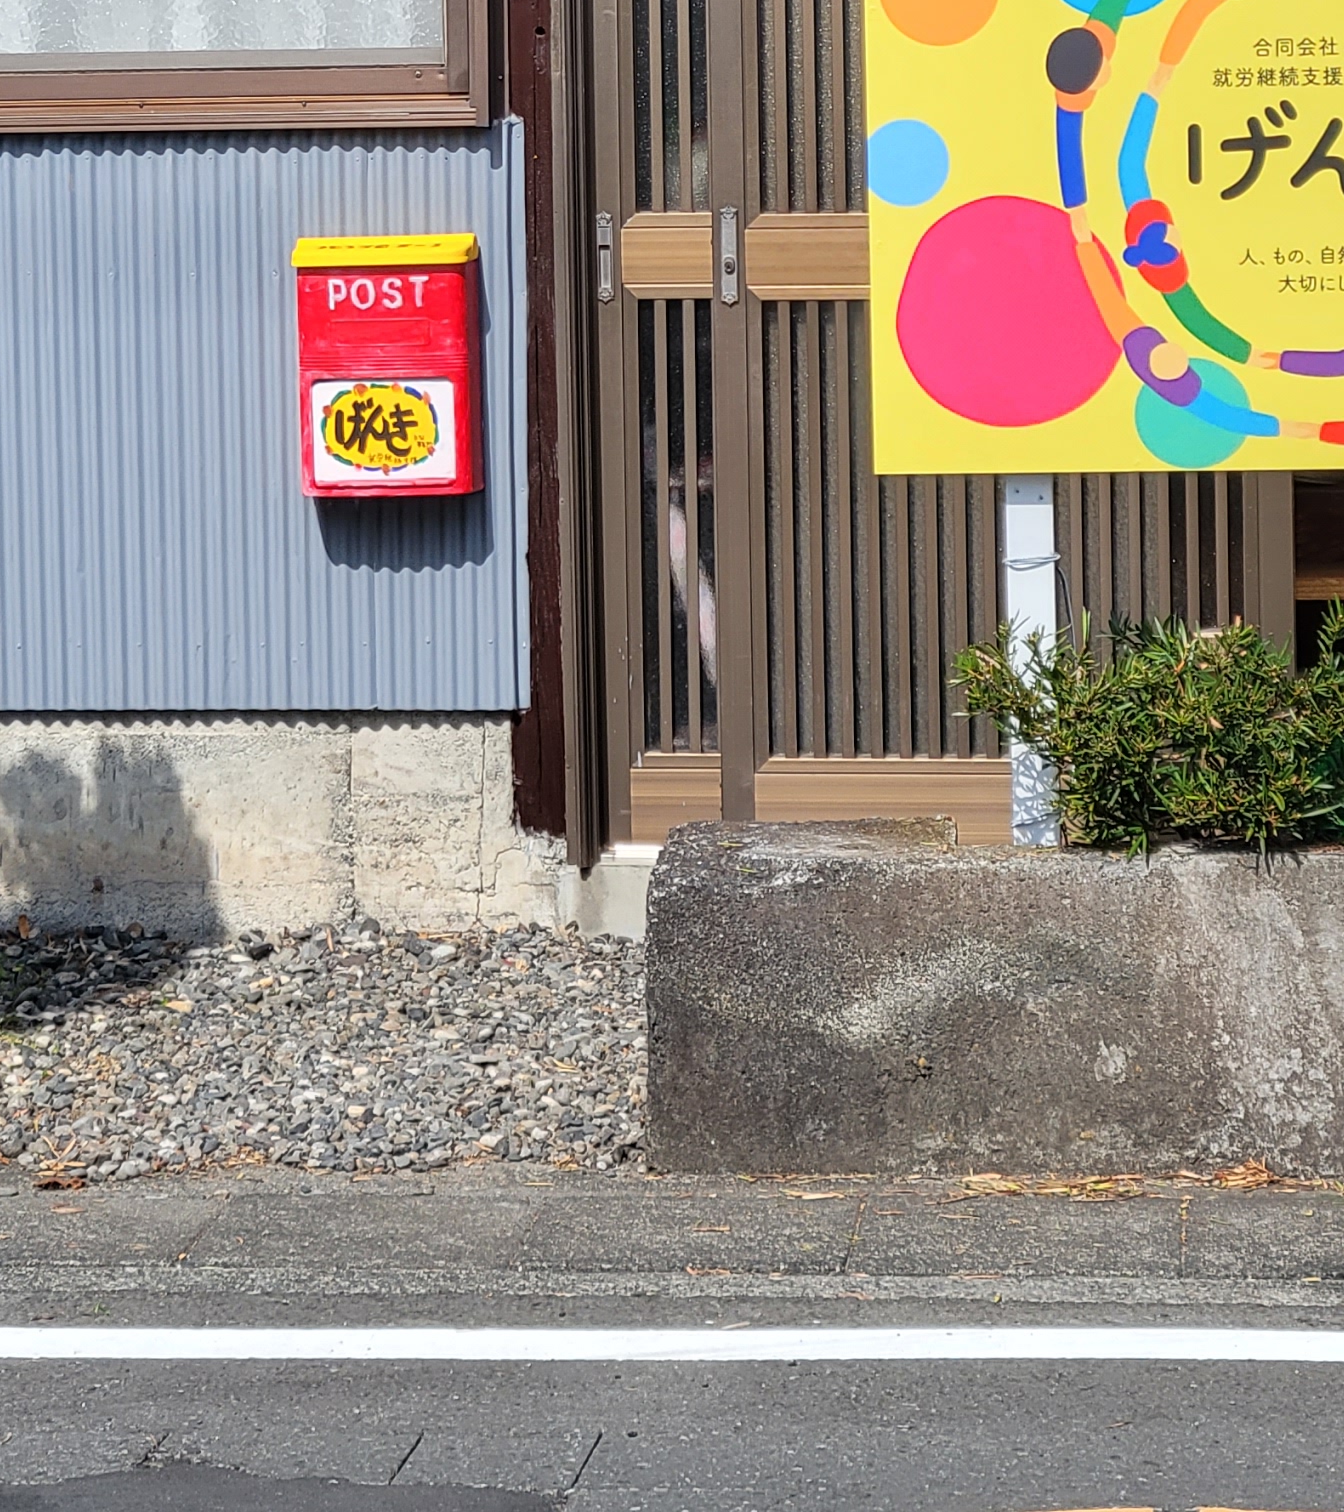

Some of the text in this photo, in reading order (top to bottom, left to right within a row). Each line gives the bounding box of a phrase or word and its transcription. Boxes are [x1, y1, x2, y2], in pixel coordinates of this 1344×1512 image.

[1253, 36, 1340, 58] 合同会社
[327, 275, 430, 311] POST
[334, 397, 419, 458] げんき
